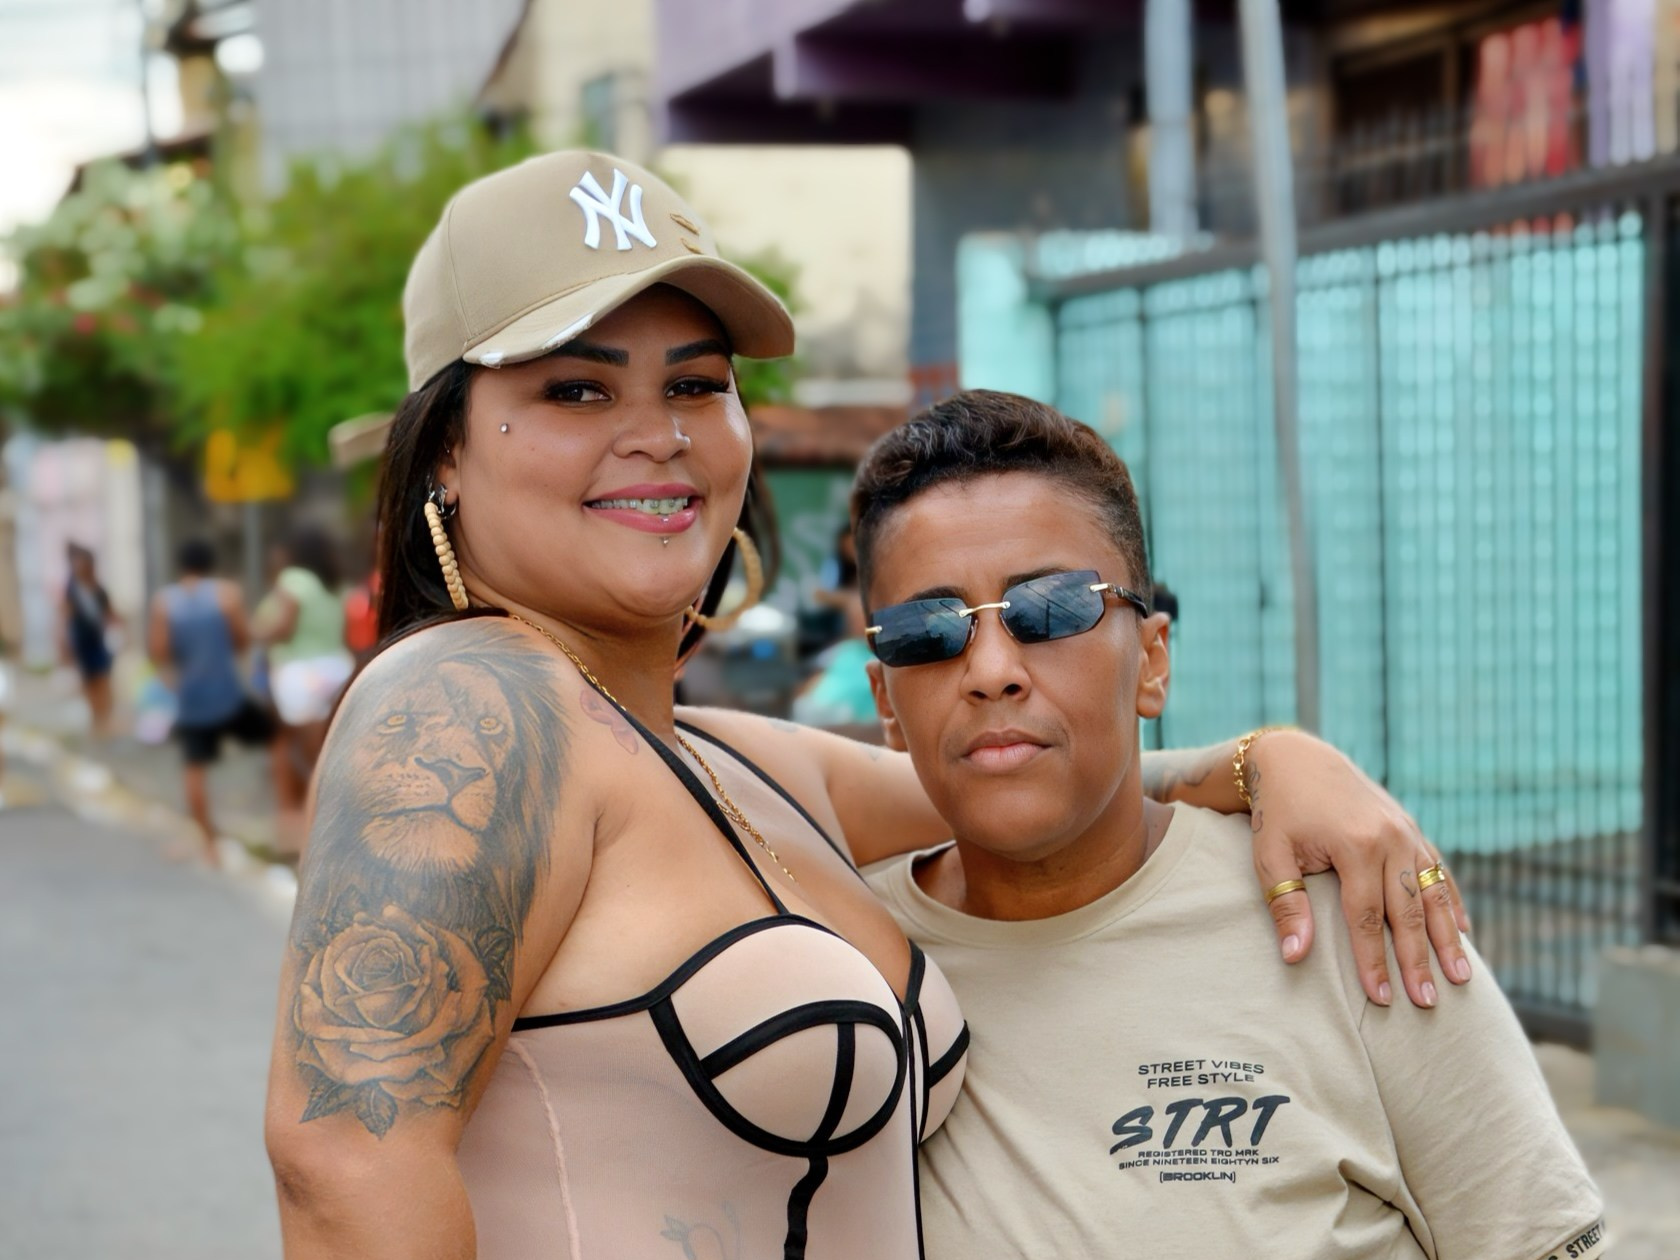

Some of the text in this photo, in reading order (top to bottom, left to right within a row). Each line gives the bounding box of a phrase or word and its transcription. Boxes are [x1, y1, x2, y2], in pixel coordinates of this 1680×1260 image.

[569, 168, 657, 250] NY
[1138, 1059, 1265, 1075] STREET VIBES
[1147, 1072, 1255, 1088] FREE STYLE
[1110, 1094, 1291, 1155] STRT
[1138, 1149, 1207, 1158] REGISTERED
[1235, 1149, 1259, 1157] MRK
[1119, 1159, 1149, 1170] SINCE
[1153, 1157, 1207, 1166] NINETEEN
[1262, 1156, 1280, 1165] SIX
[1566, 1224, 1602, 1259] STREET
